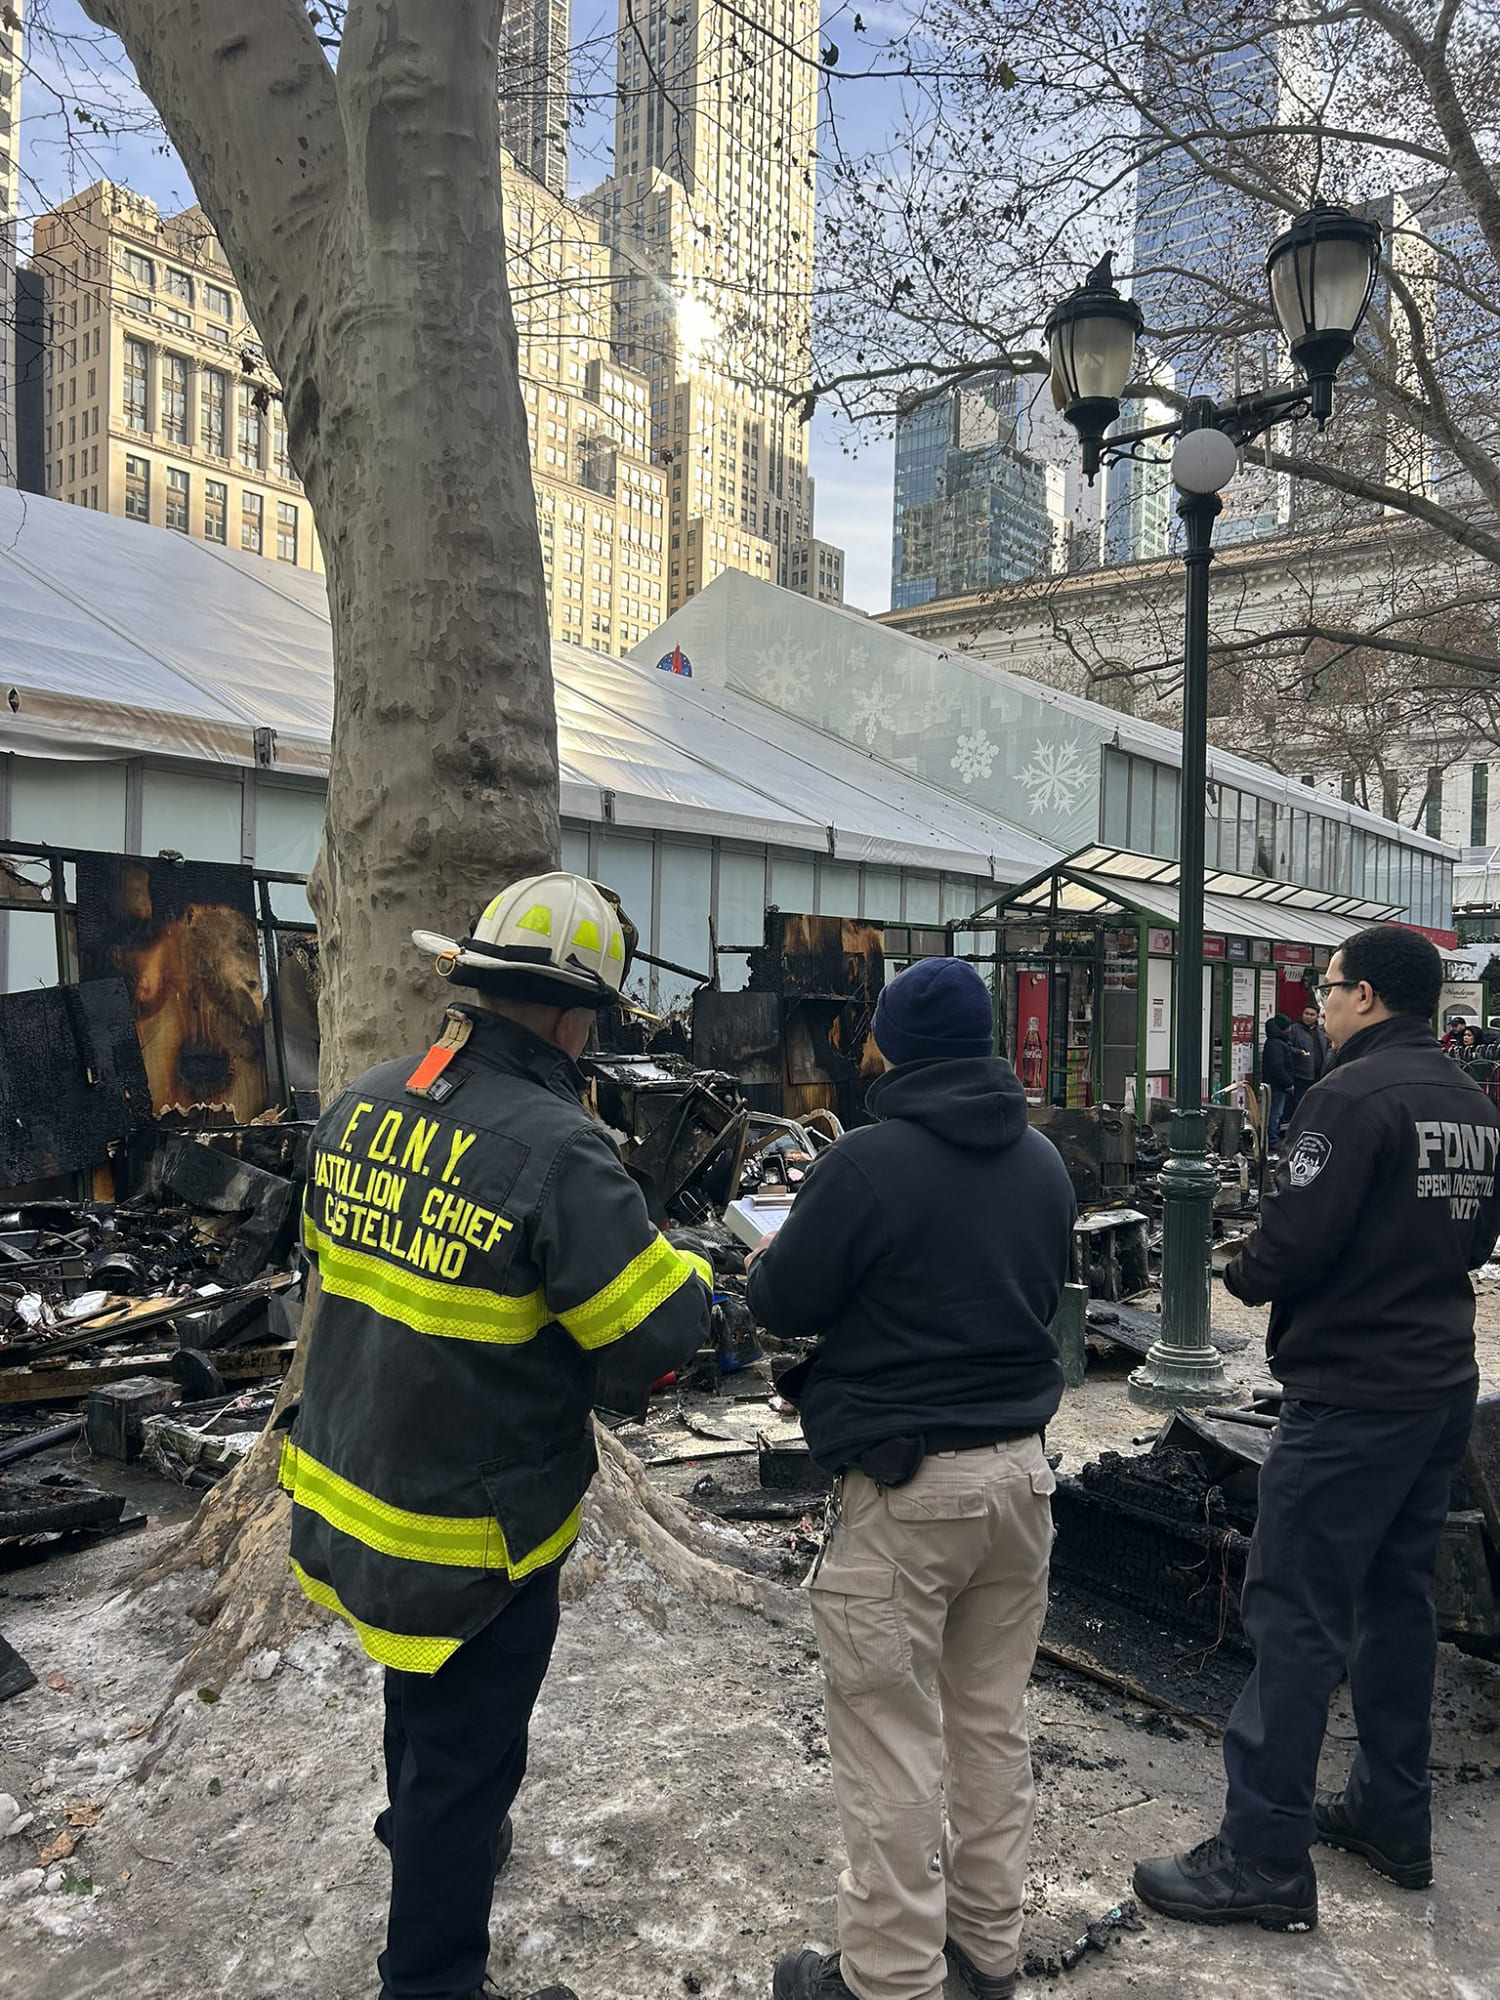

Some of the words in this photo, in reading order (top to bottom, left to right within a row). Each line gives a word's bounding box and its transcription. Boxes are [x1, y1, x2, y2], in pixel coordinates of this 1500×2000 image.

[1415, 1121, 1500, 1172] FDNY
[325, 1192, 468, 1280] CSTELLANO
[421, 1187, 514, 1253] CHIEF
